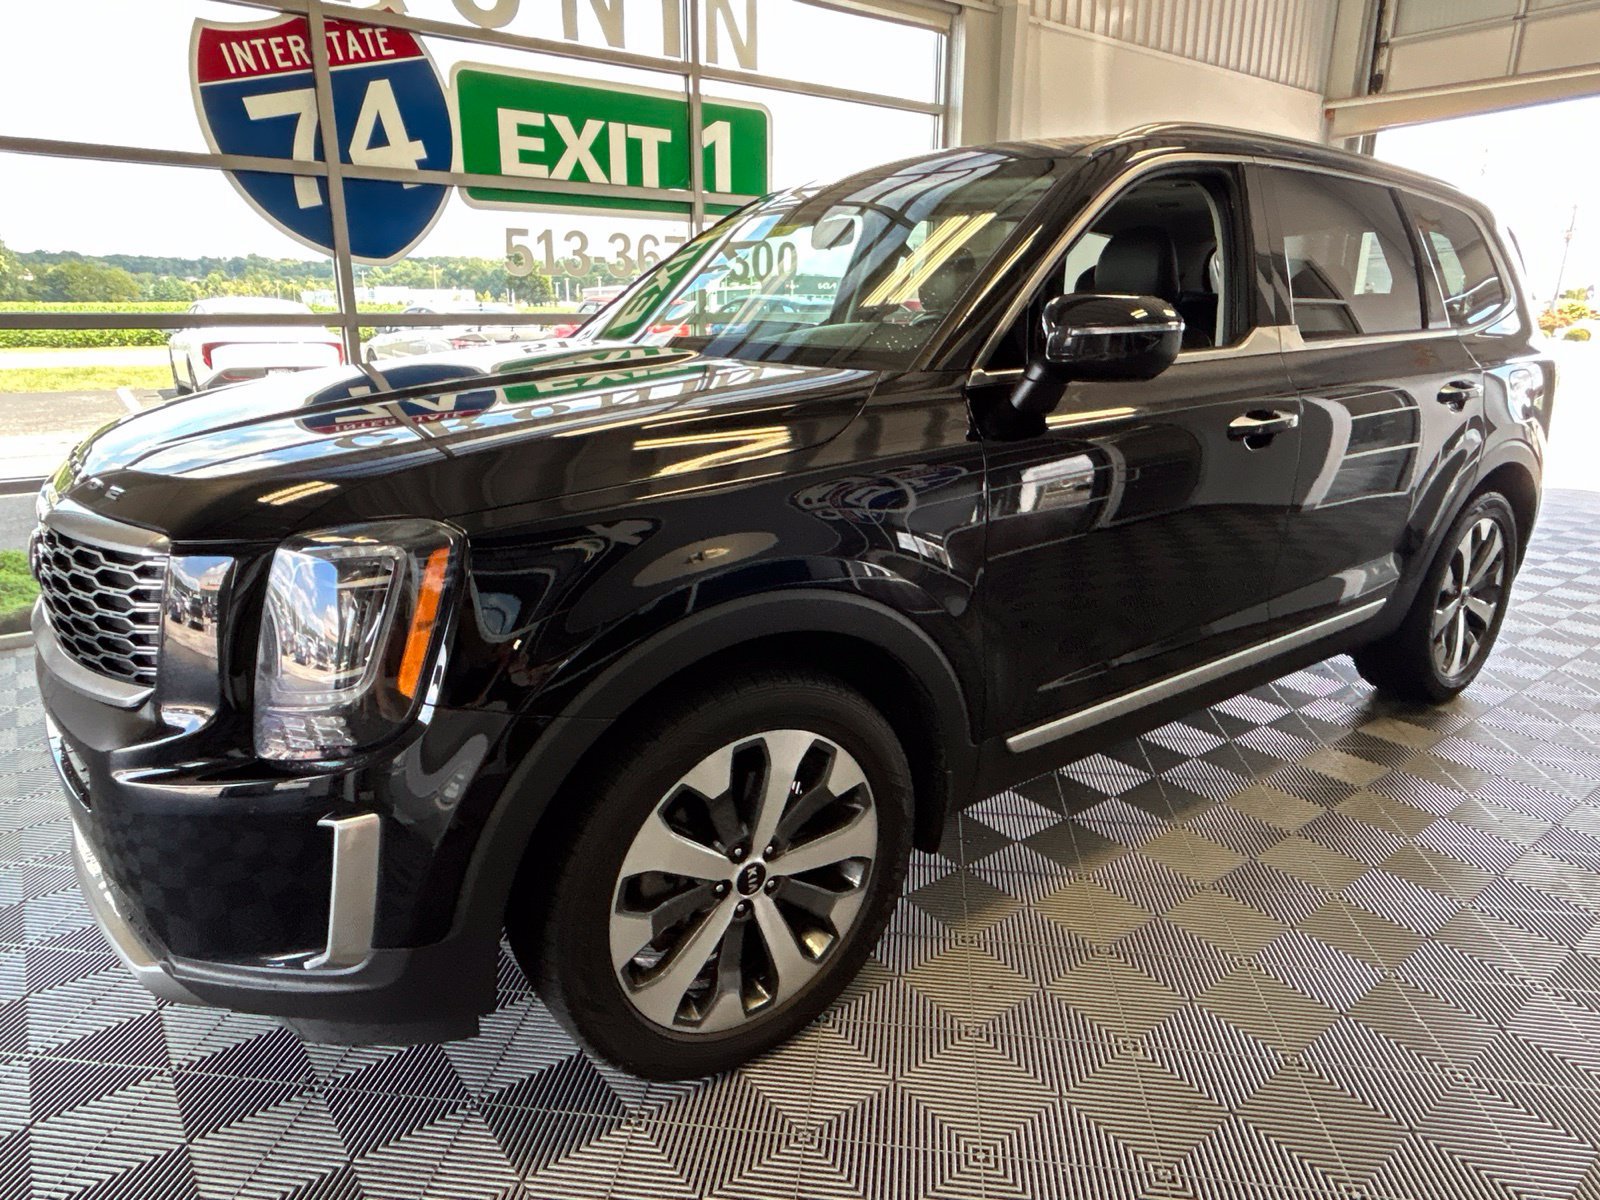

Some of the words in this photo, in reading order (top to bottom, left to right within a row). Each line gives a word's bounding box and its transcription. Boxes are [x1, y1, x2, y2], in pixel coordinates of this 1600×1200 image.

[219, 28, 396, 74] INTERTATE
[242, 79, 428, 209] 74
[497, 107, 673, 189] EXIT
[702, 120, 732, 193] 1
[747, 866, 758, 893] KIA
